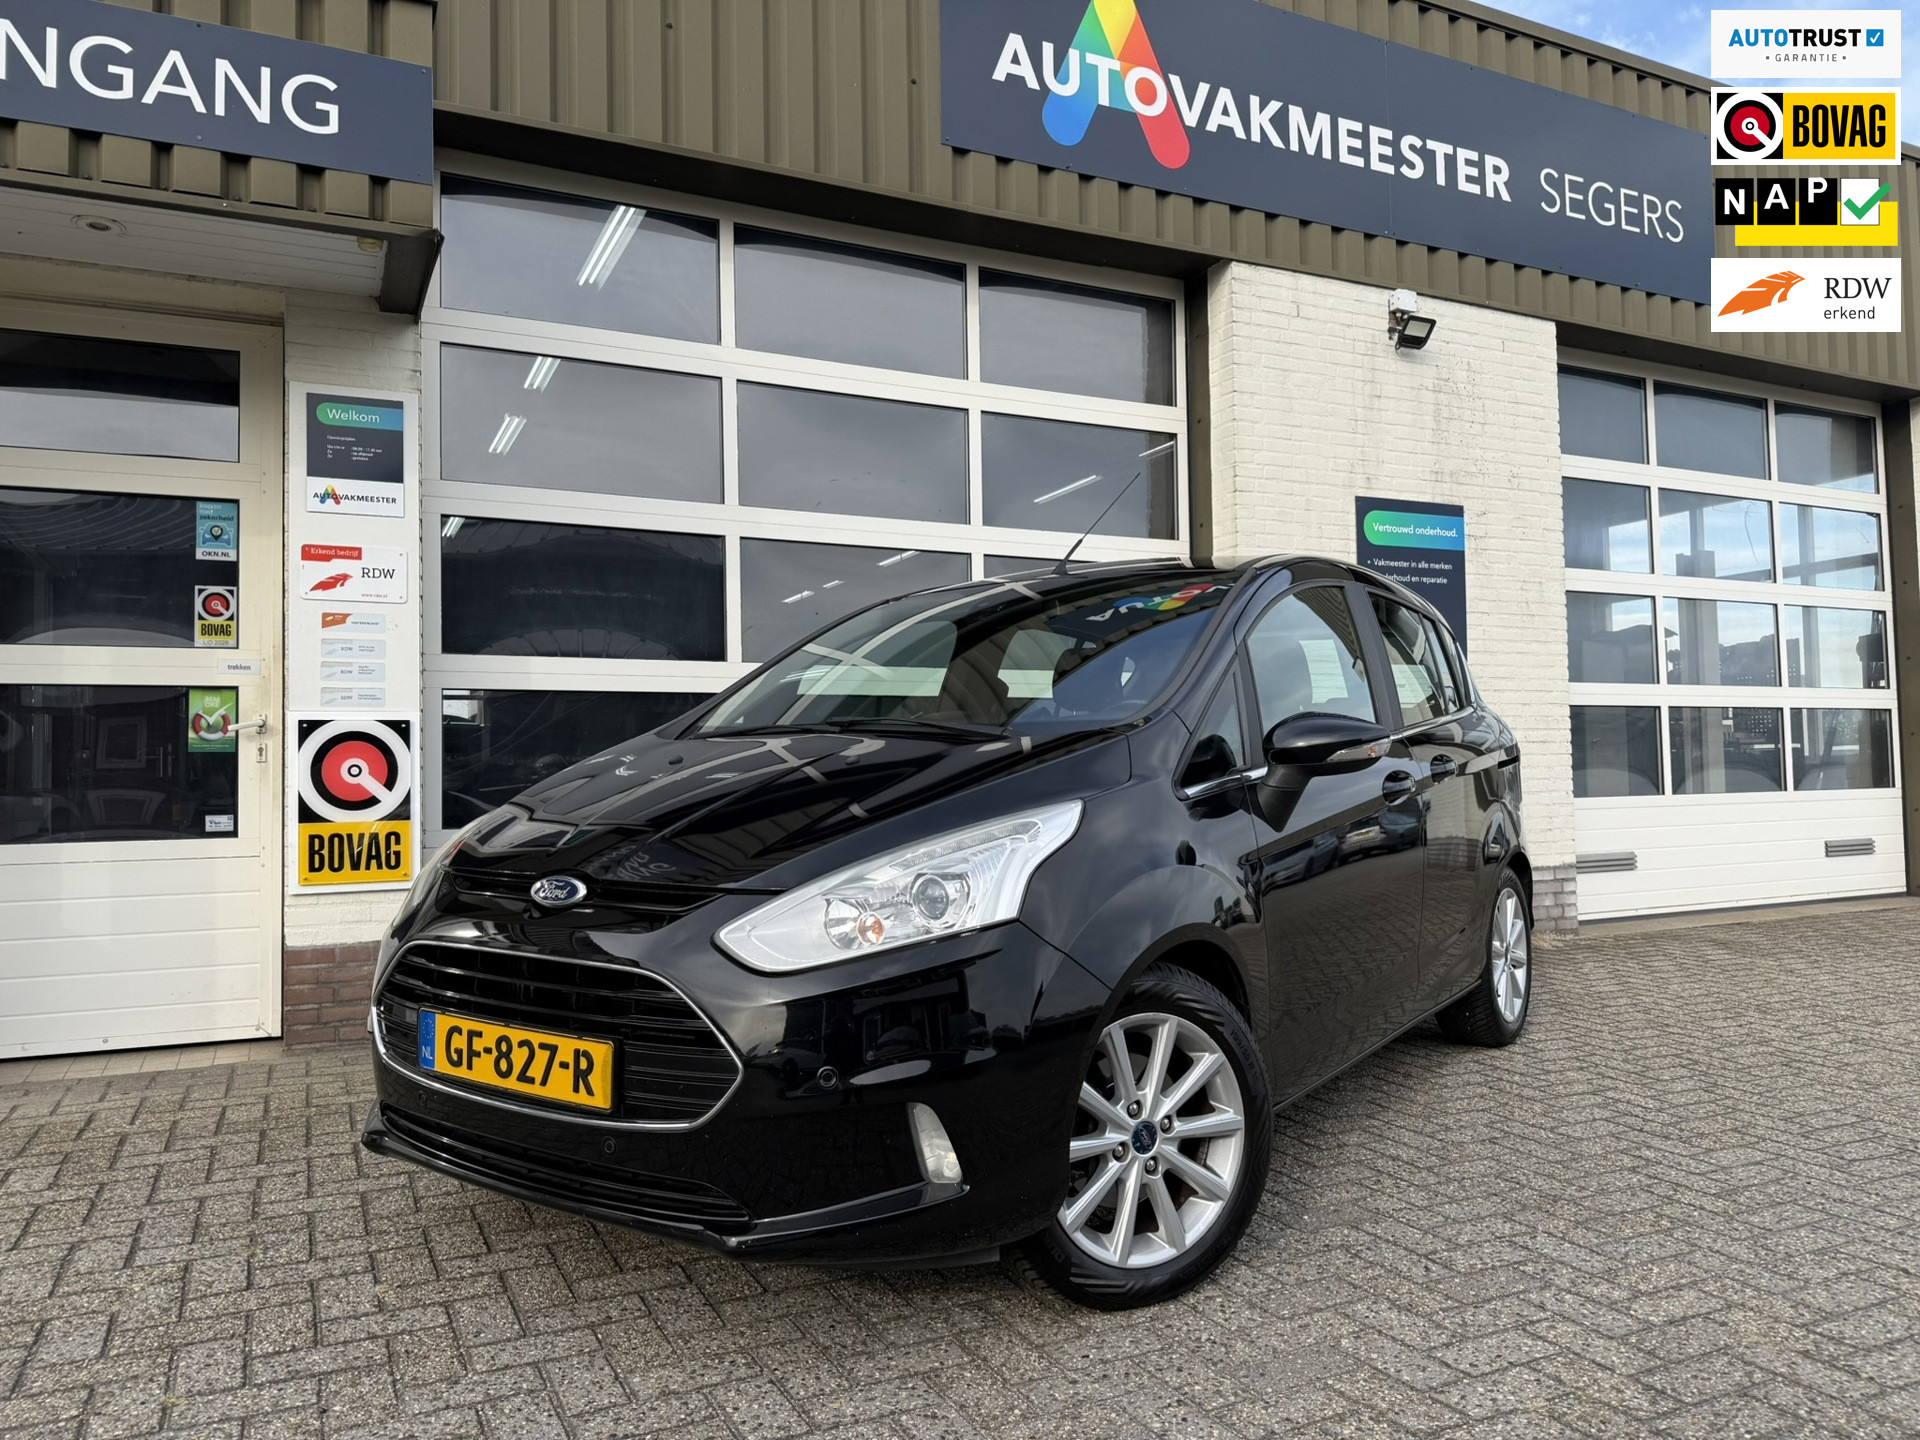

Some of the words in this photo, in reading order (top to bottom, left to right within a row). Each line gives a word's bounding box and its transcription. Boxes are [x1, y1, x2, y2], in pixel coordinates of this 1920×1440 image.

[992, 32, 1512, 203] AUTOVAKMEESTER
[1539, 167, 1685, 244] SEGERS
[326, 408, 380, 423] Welkom
[313, 492, 397, 504] AUTOVAKMEESTER
[1372, 522, 1414, 534] Vertrouwd
[1415, 526, 1458, 538] onderhoud.
[202, 550, 231, 558] OKN.NL
[310, 548, 336, 556] Erkend
[336, 549, 359, 557] bedrijf
[1373, 558, 1410, 568] Vakmeester
[1410, 560, 1417, 568] in
[1418, 560, 1429, 568] alle
[1430, 562, 1452, 570] merken
[361, 567, 396, 579] RDW
[1384, 573, 1410, 582] derhoud
[1420, 576, 1448, 584] reparatie
[200, 623, 232, 637] BOVAG
[308, 831, 402, 873] BOVAG
[539, 880, 571, 900] Ford
[421, 1046, 434, 1060] NL
[444, 1024, 595, 1097] GF-827-R
